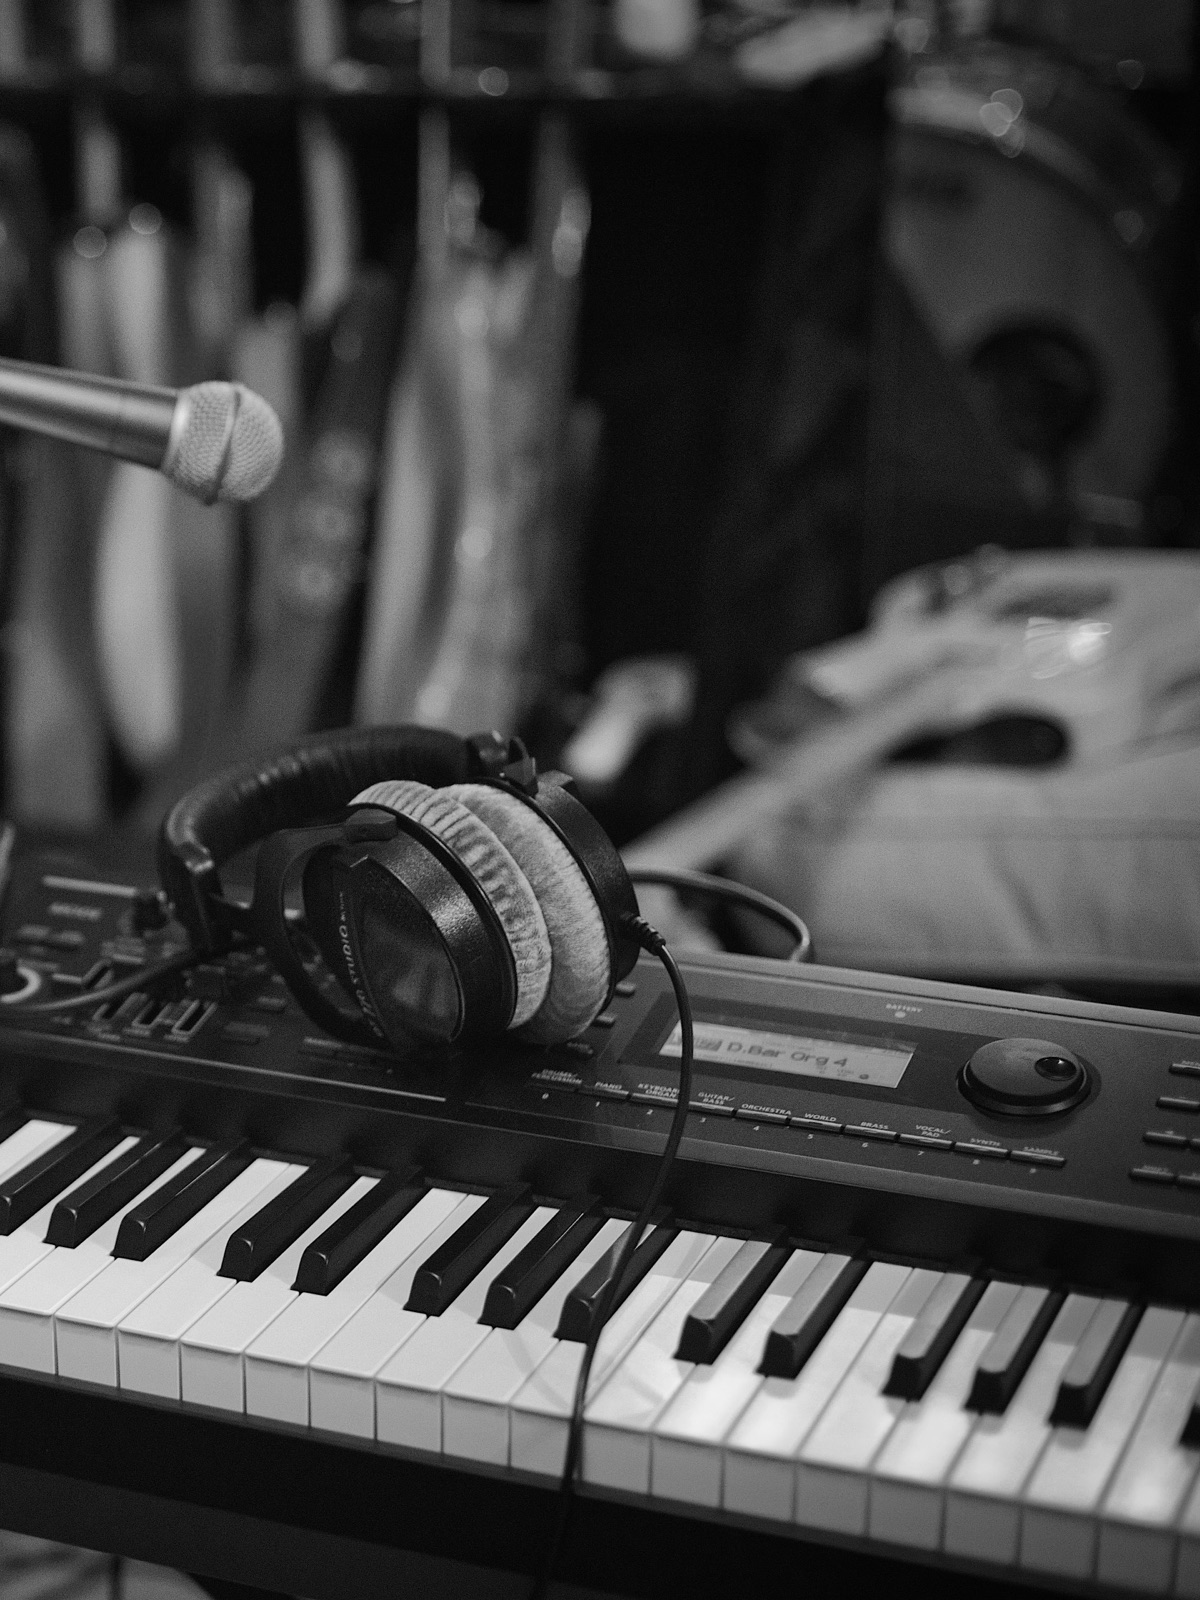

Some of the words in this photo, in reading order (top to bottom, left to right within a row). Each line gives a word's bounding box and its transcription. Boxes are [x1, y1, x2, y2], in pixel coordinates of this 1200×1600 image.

[338, 925, 359, 985] STUDIO
[726, 1041, 787, 1059] D.Bar
[790, 1050, 830, 1067] Org
[833, 1057, 849, 1068] 4
[531, 1073, 583, 1085] PERCUSSION
[594, 1081, 623, 1091] PIANO
[645, 1089, 678, 1099] ORGAN
[698, 1092, 736, 1103] GUITAR/
[702, 1098, 725, 1106] BASS
[741, 1103, 792, 1116] ORCHESTRA
[804, 1113, 837, 1123] WORLD
[860, 1121, 890, 1131] BRASS
[915, 1124, 952, 1136] VOCAL/
[921, 1130, 940, 1138] PAD
[969, 1138, 1001, 1148] SYNTH
[1022, 1146, 1061, 1157] SAMPLE
